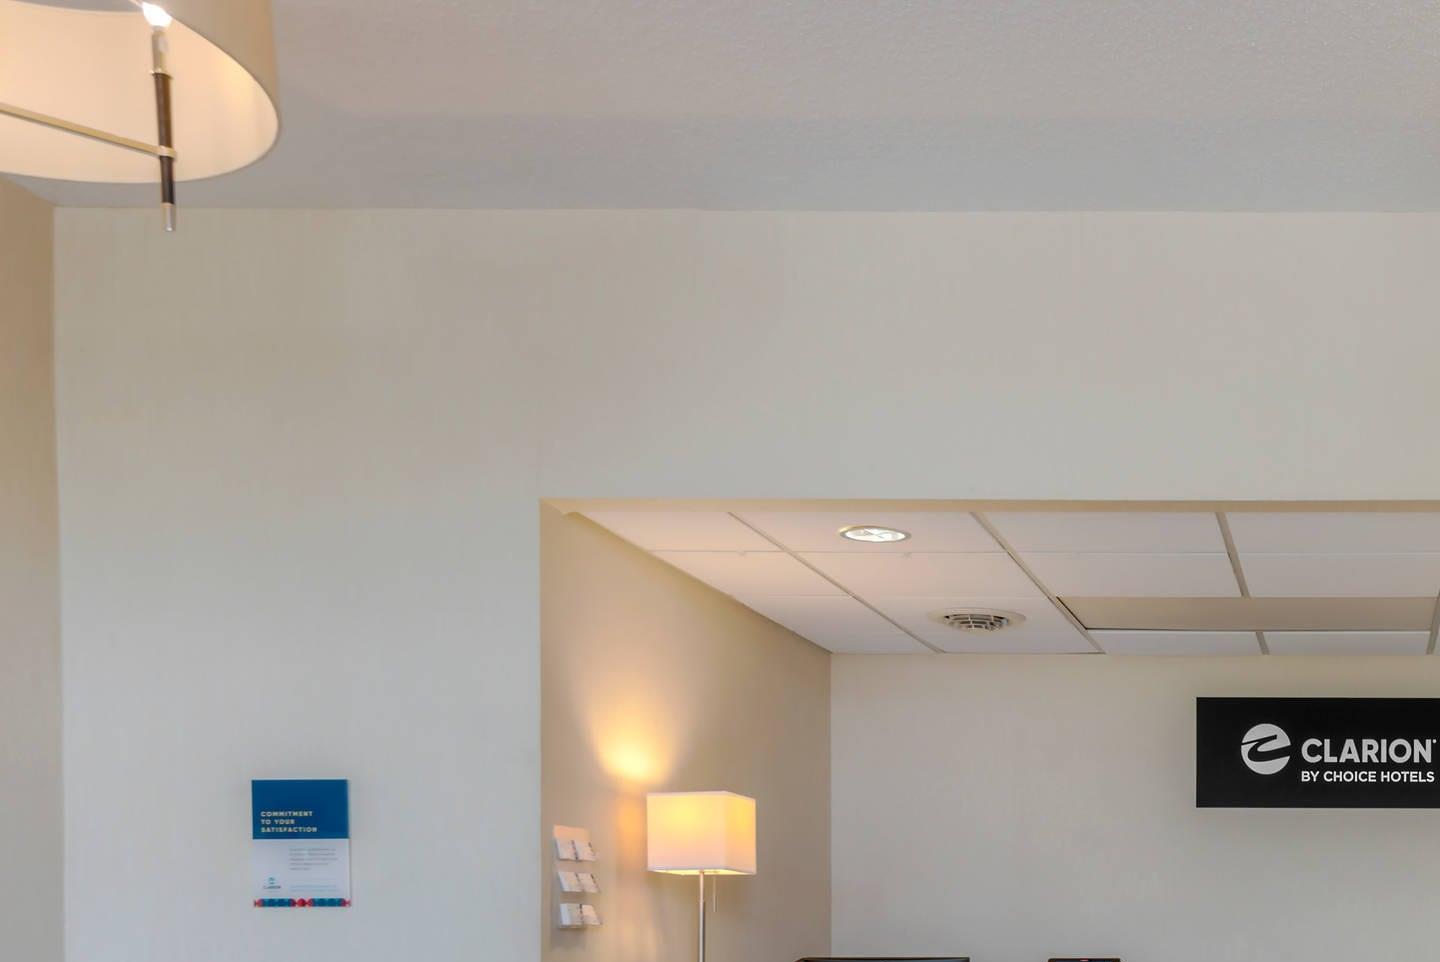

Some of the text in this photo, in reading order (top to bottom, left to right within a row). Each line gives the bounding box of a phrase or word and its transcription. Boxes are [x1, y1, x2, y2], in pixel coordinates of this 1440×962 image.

[1301, 738, 1432, 763] CLARION
[1301, 770, 1435, 782] BY CHOICE HOTELS
